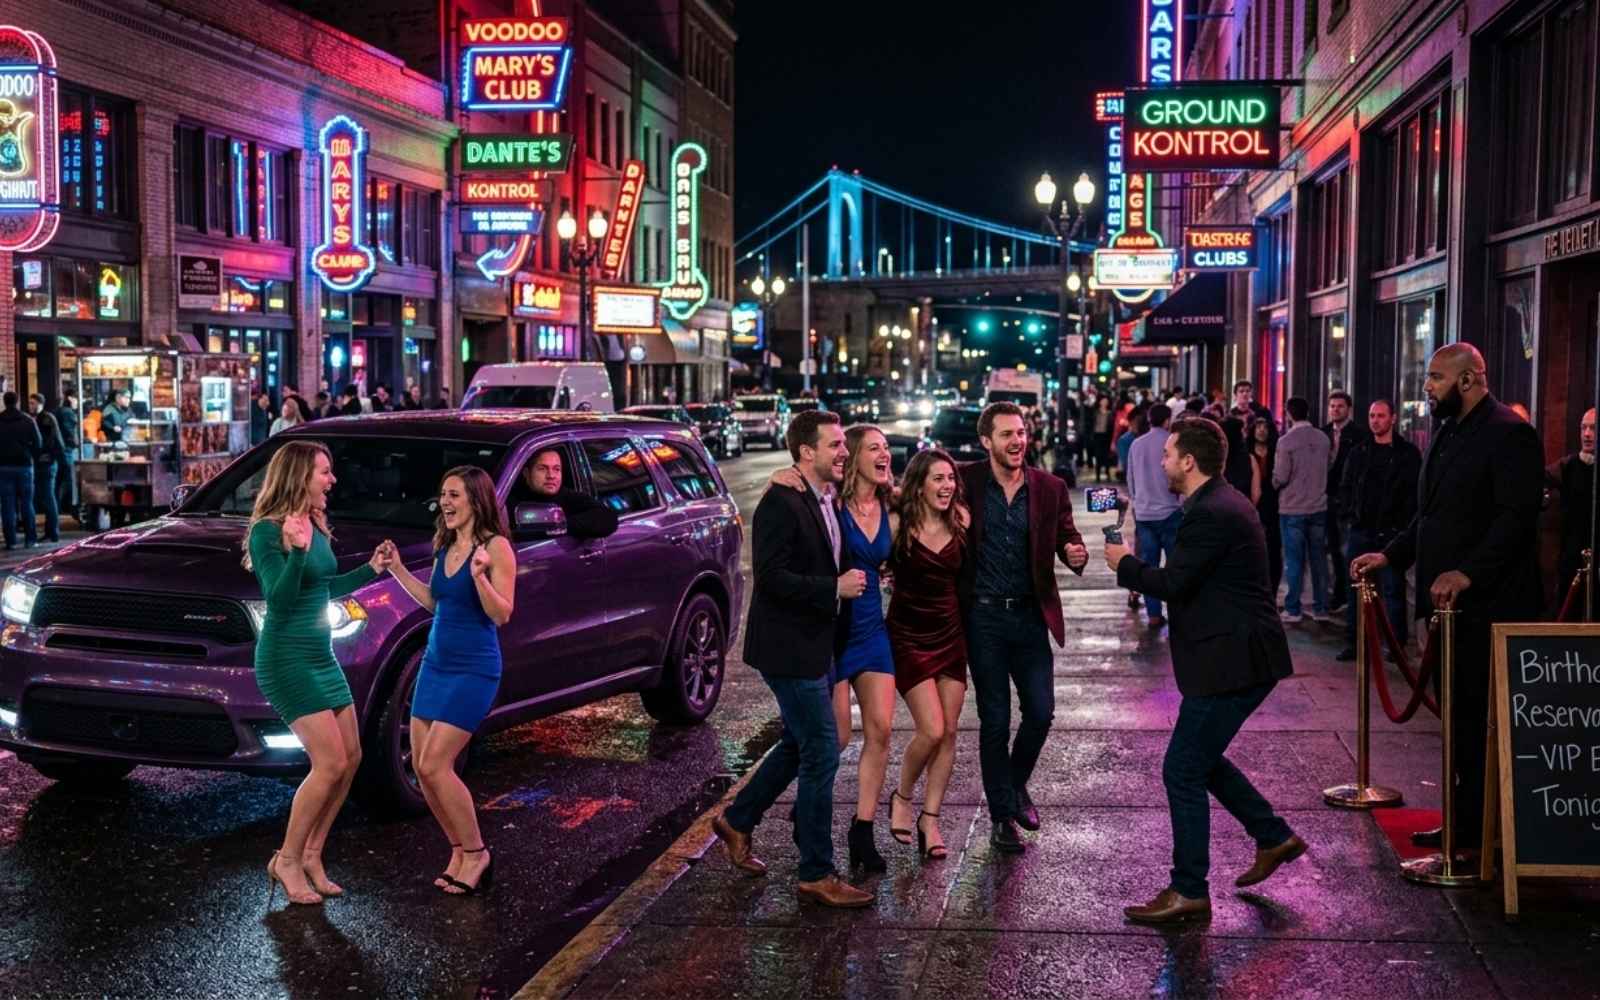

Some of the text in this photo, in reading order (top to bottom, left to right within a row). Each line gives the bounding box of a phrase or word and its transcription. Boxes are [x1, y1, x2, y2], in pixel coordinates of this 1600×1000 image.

[465, 22, 563, 42] VOODOO
[1150, 0, 1173, 83] ARS
[475, 54, 555, 76] MARY'S
[484, 80, 541, 100] CLUB
[1142, 99, 1266, 124] GROUND
[467, 141, 562, 163] DANTE'S
[1133, 130, 1270, 156] KONTROL
[331, 138, 351, 244] MARYS
[467, 183, 539, 198] KONTROL
[1194, 251, 1248, 266] CLUBS
